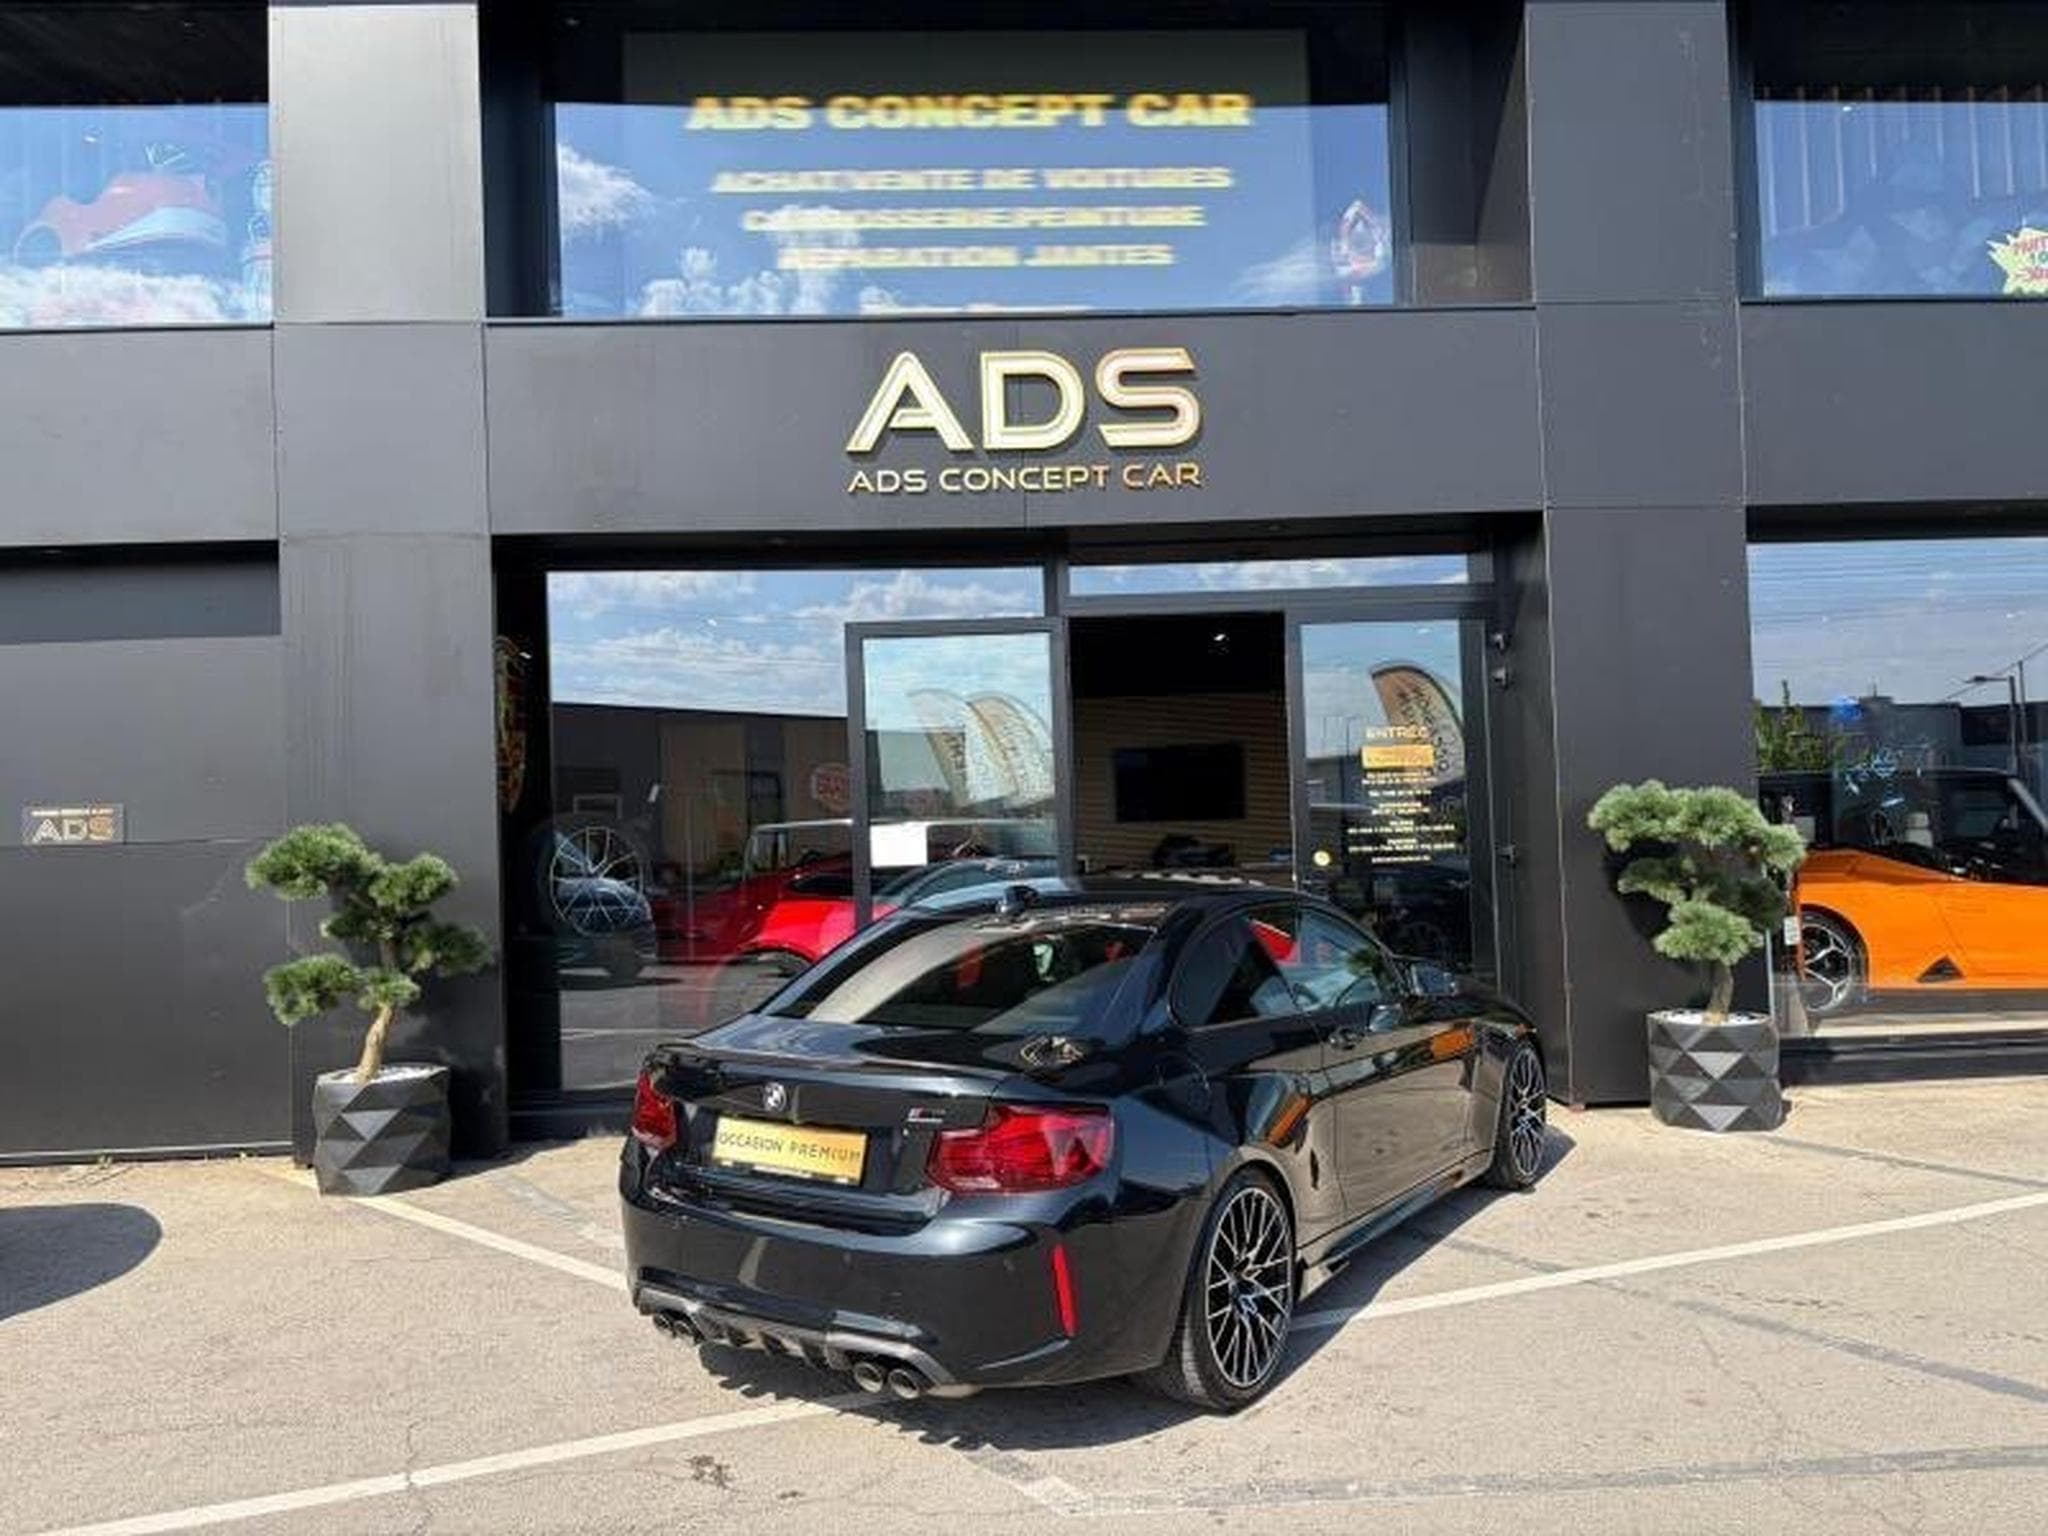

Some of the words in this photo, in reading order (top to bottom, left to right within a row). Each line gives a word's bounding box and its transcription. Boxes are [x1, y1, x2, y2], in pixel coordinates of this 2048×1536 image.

[685, 97, 813, 131] ADS
[825, 94, 1114, 129] CONCEPT
[1126, 93, 1254, 127] CAR
[846, 347, 1202, 454] ADS
[847, 468, 927, 495] ADS
[938, 464, 1111, 493] CONCEPT
[1121, 461, 1202, 489] CAR
[31, 818, 114, 843] ADS
[718, 1132, 784, 1154] OCCASION
[790, 1139, 862, 1163] PREMIUM
